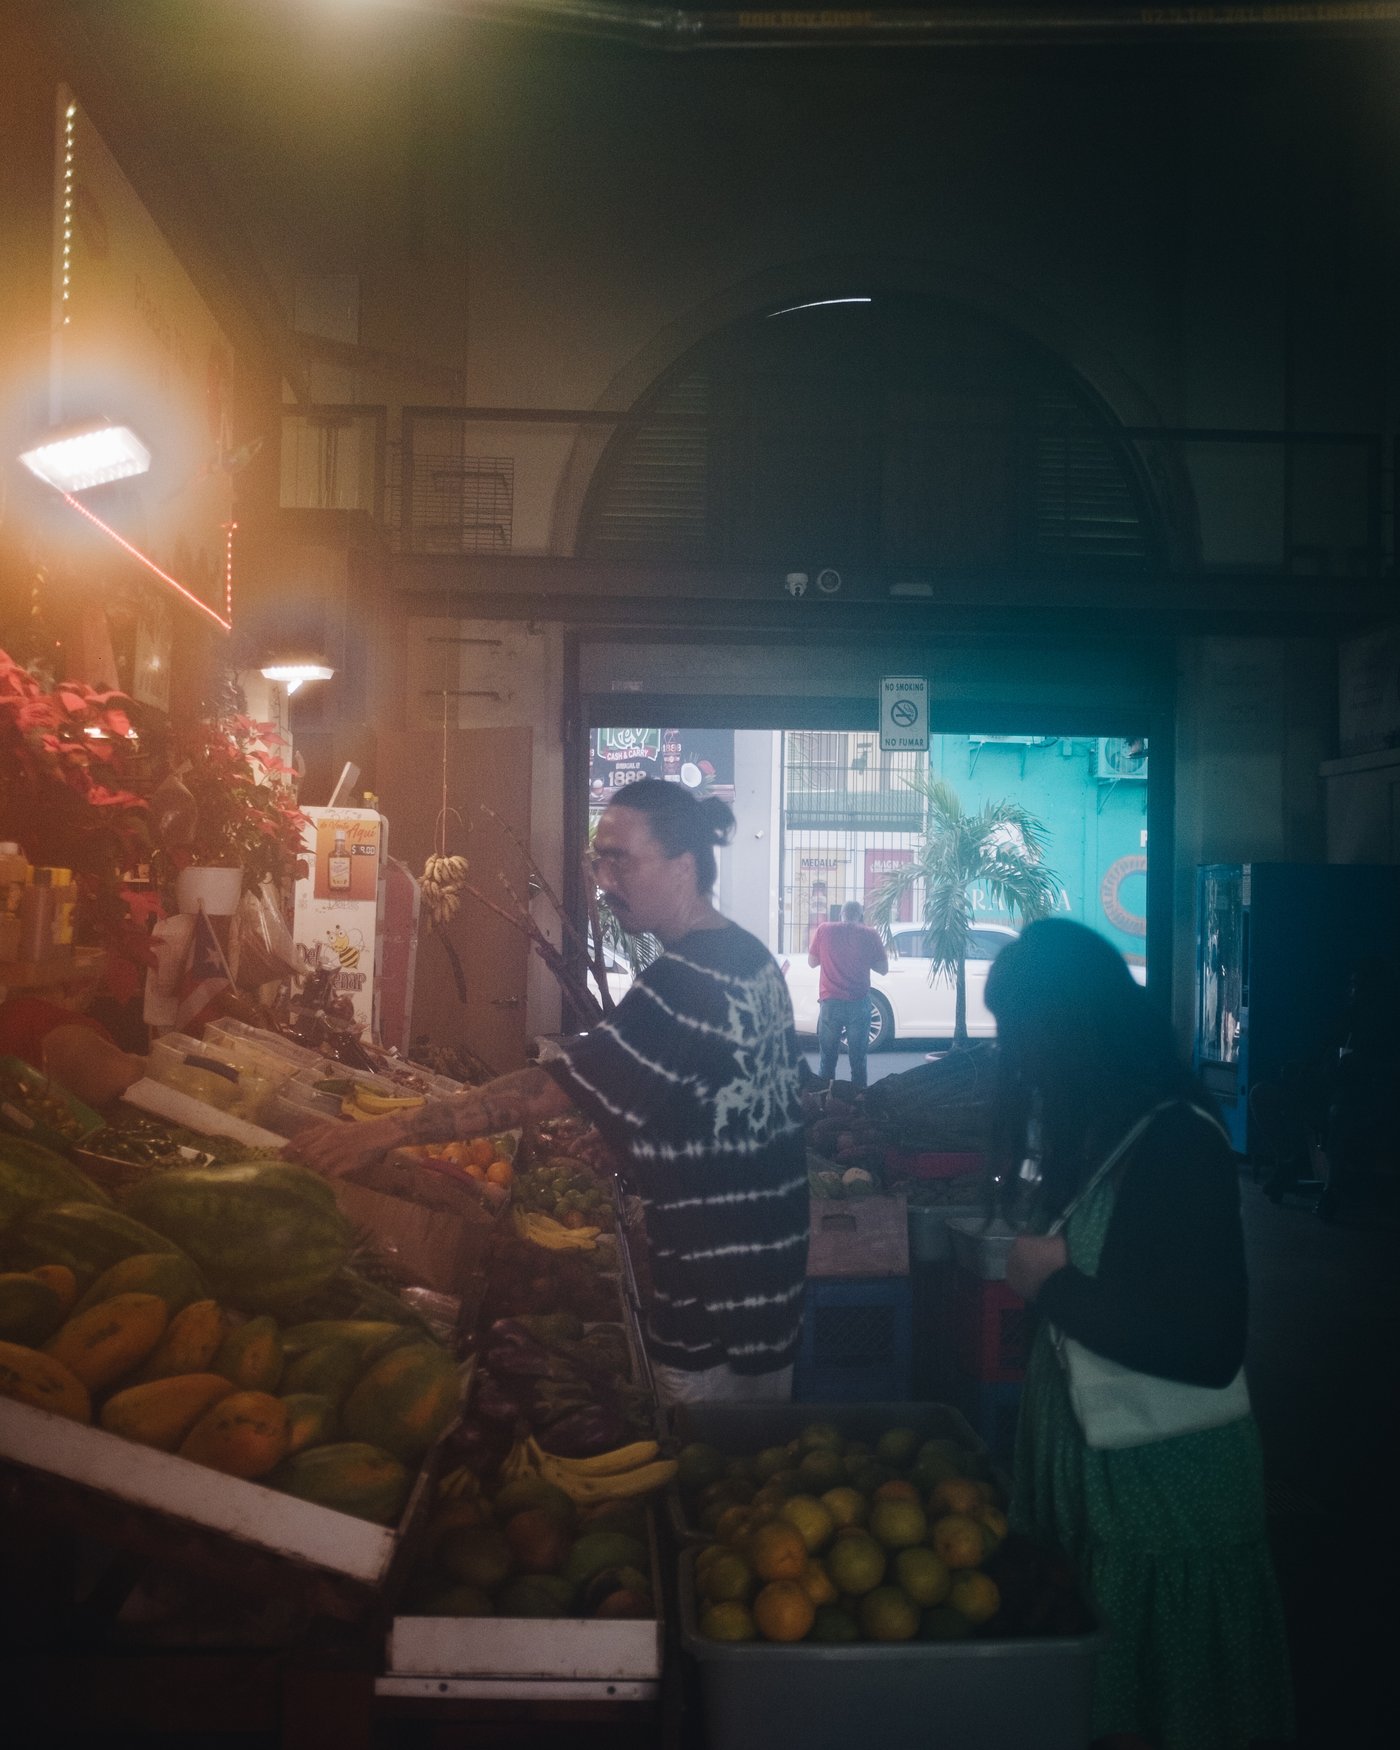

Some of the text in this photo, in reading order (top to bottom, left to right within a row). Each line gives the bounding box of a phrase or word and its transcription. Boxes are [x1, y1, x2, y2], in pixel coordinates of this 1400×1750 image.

[884, 683, 924, 692] NO SMOKING
[885, 738, 924, 747] NO FUMAR
[607, 748, 649, 761] CASH & CARRY
[801, 858, 838, 868] MEDALLA
[873, 859, 904, 868] MAGN
